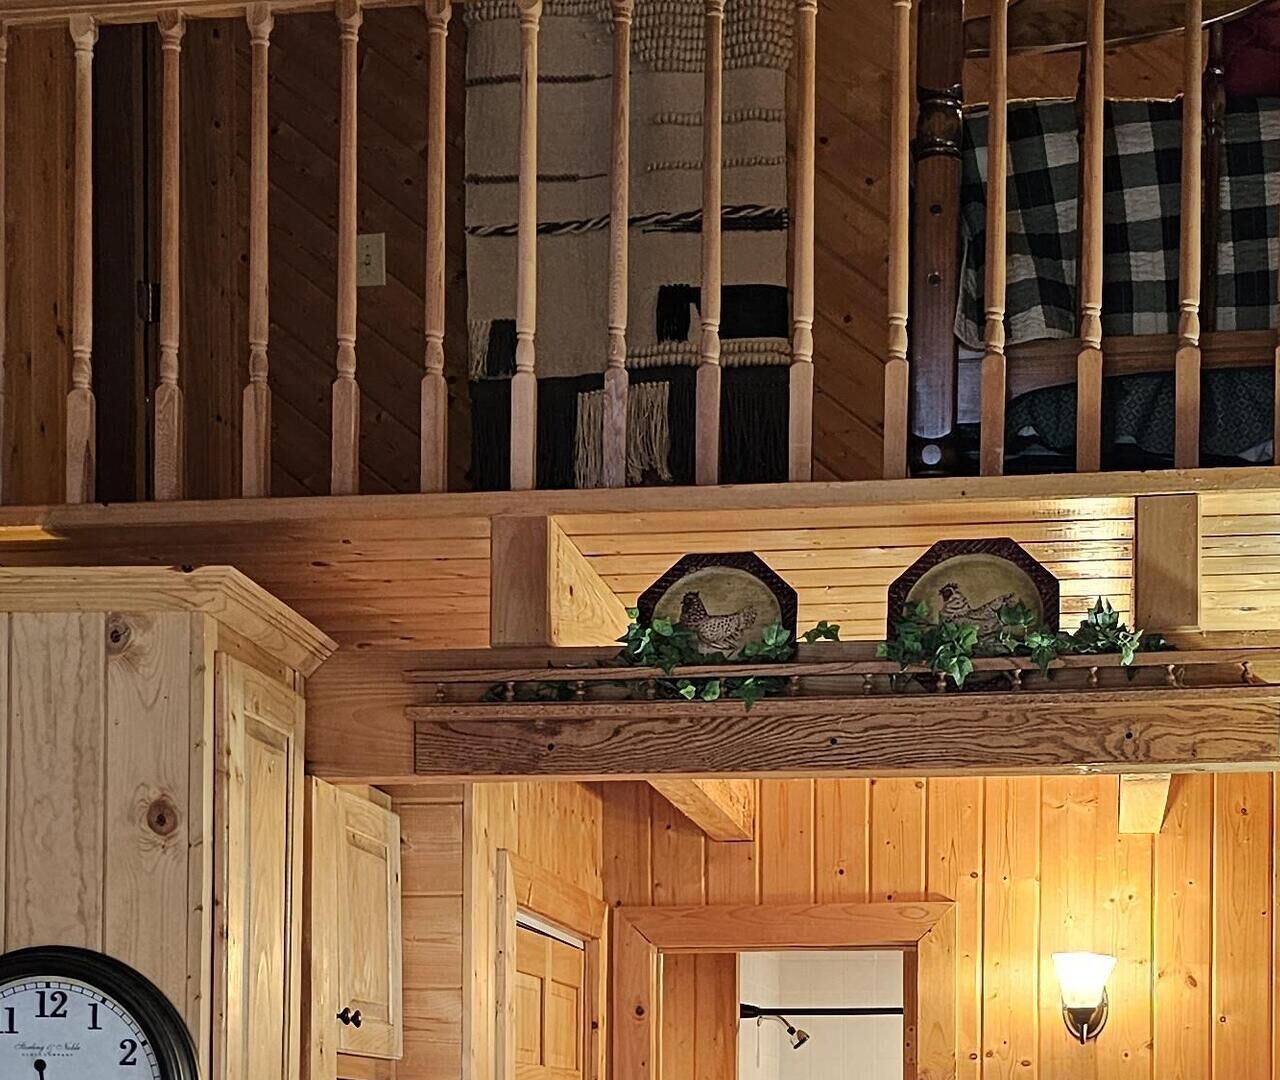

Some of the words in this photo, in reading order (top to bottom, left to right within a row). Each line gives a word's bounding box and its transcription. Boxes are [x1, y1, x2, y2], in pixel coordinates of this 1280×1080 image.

[34, 990, 69, 1018] 12
[87, 1003, 103, 1031] 1
[118, 1038, 138, 1066] 2
